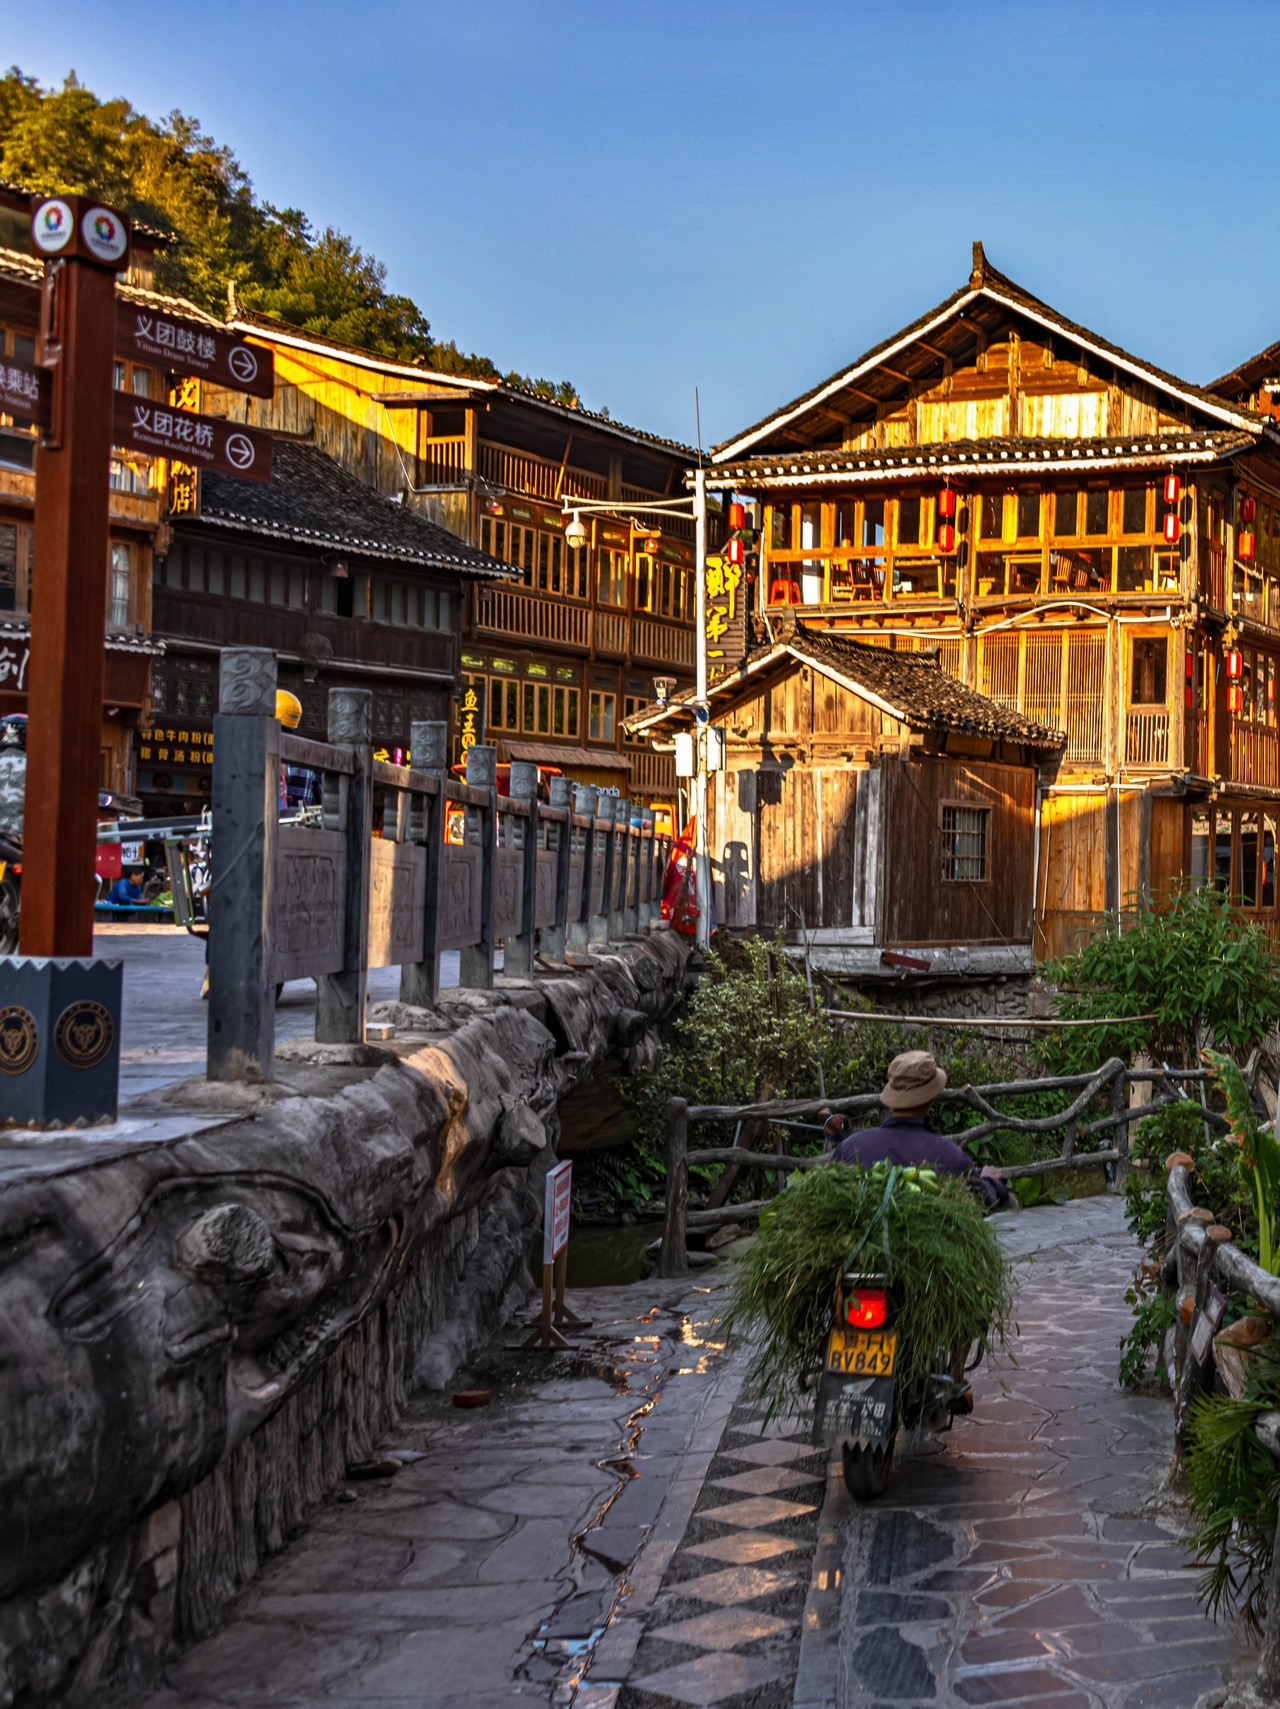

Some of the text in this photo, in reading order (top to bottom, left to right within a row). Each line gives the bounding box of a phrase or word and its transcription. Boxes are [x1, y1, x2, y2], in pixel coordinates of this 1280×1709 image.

[134, 314, 216, 361] 义团鼓楼
[163, 346, 185, 363] Drum
[186, 355, 210, 370] Tower
[132, 405, 214, 448] 义团花桥
[191, 446, 215, 460] Bridge
[831, 1350, 891, 1372] BV849
